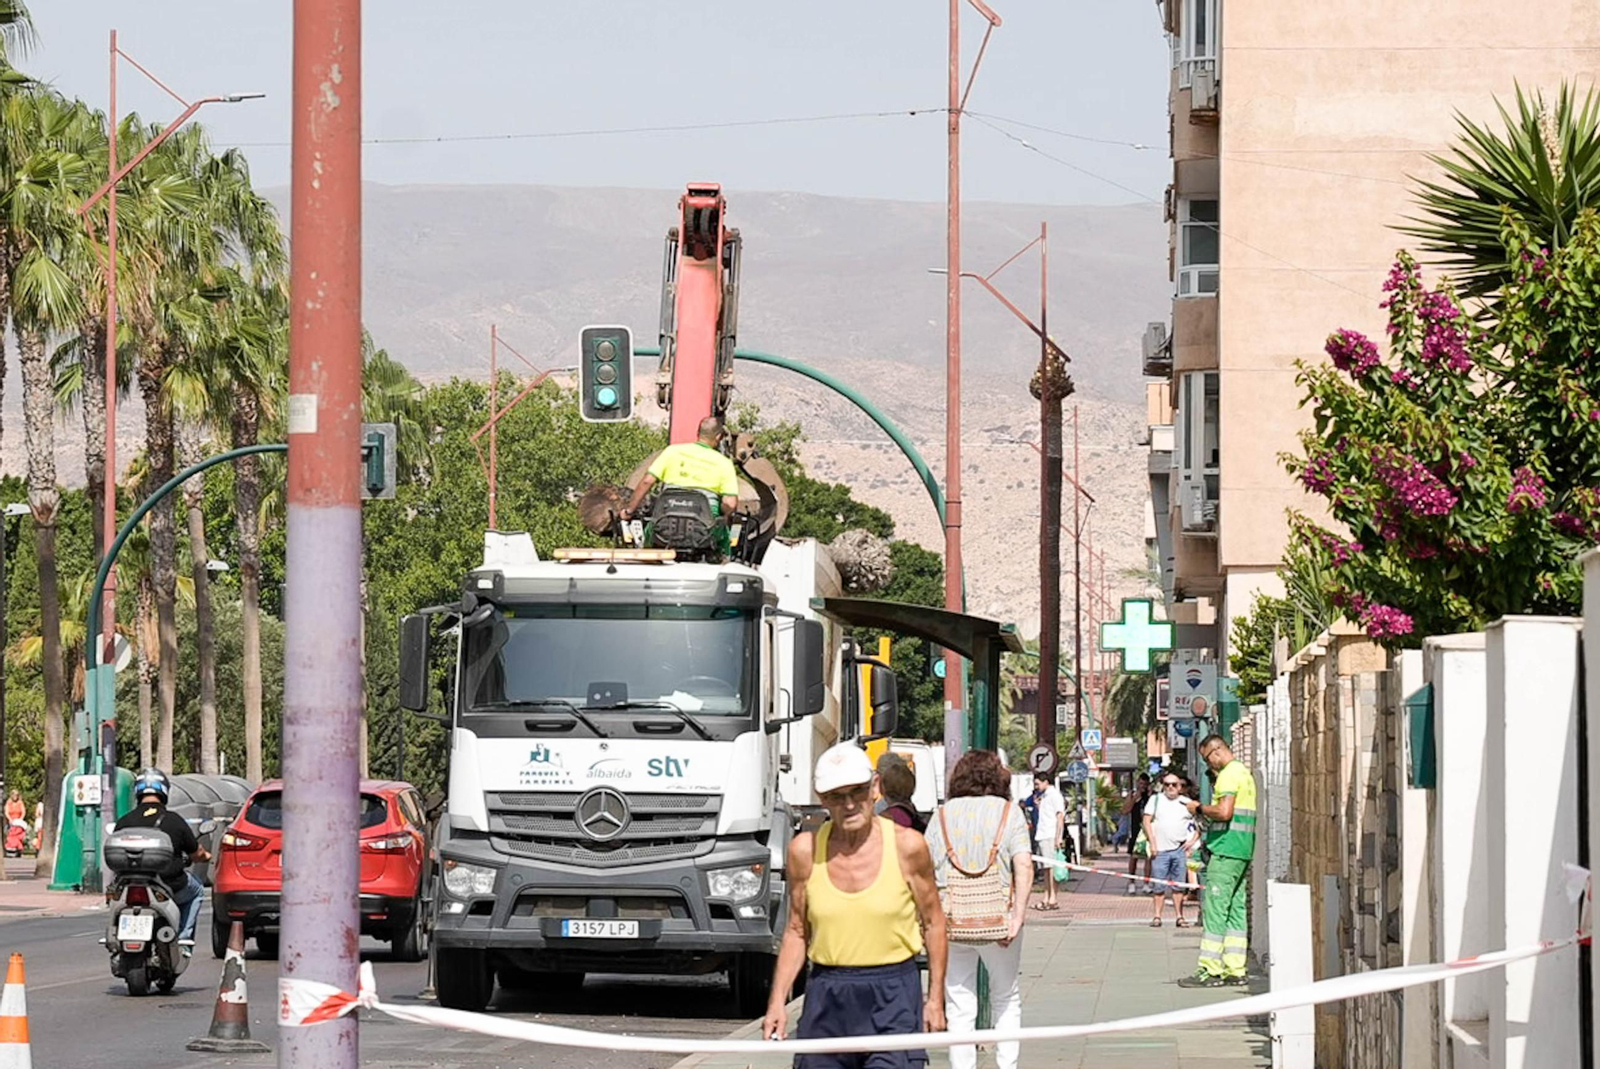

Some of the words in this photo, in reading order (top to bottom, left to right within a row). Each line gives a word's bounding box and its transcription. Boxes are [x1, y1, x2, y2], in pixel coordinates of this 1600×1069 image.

[586, 768, 632, 779] albaida
[647, 756, 690, 777] stv
[572, 922, 605, 935] 3157
[609, 923, 635, 936] LPJ
